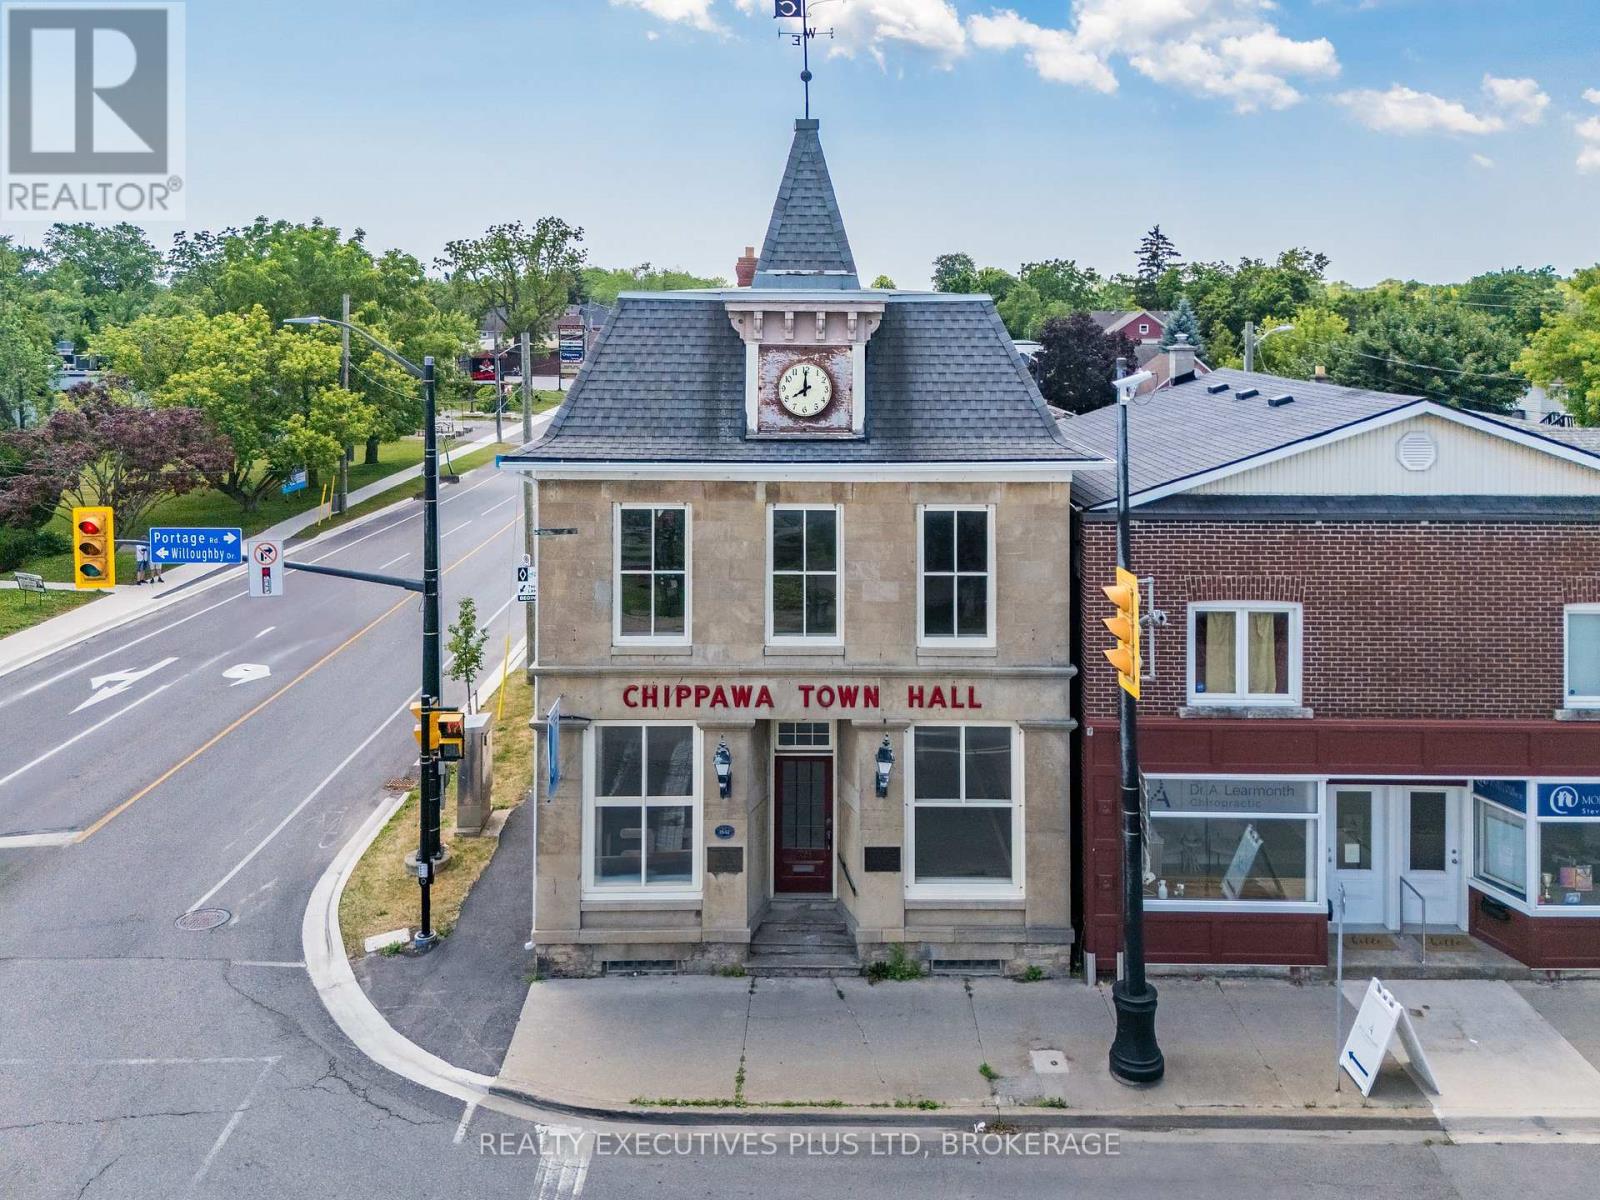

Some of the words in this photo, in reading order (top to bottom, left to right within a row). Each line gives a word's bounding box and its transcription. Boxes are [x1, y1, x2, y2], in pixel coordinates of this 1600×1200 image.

[154, 532, 205, 546] Portage
[171, 547, 224, 562] Willoughby
[623, 684, 775, 708] CHIPPAWA
[798, 685, 880, 708] TOWN
[907, 685, 982, 709] HALL
[1225, 784, 1295, 797] Learmonth
